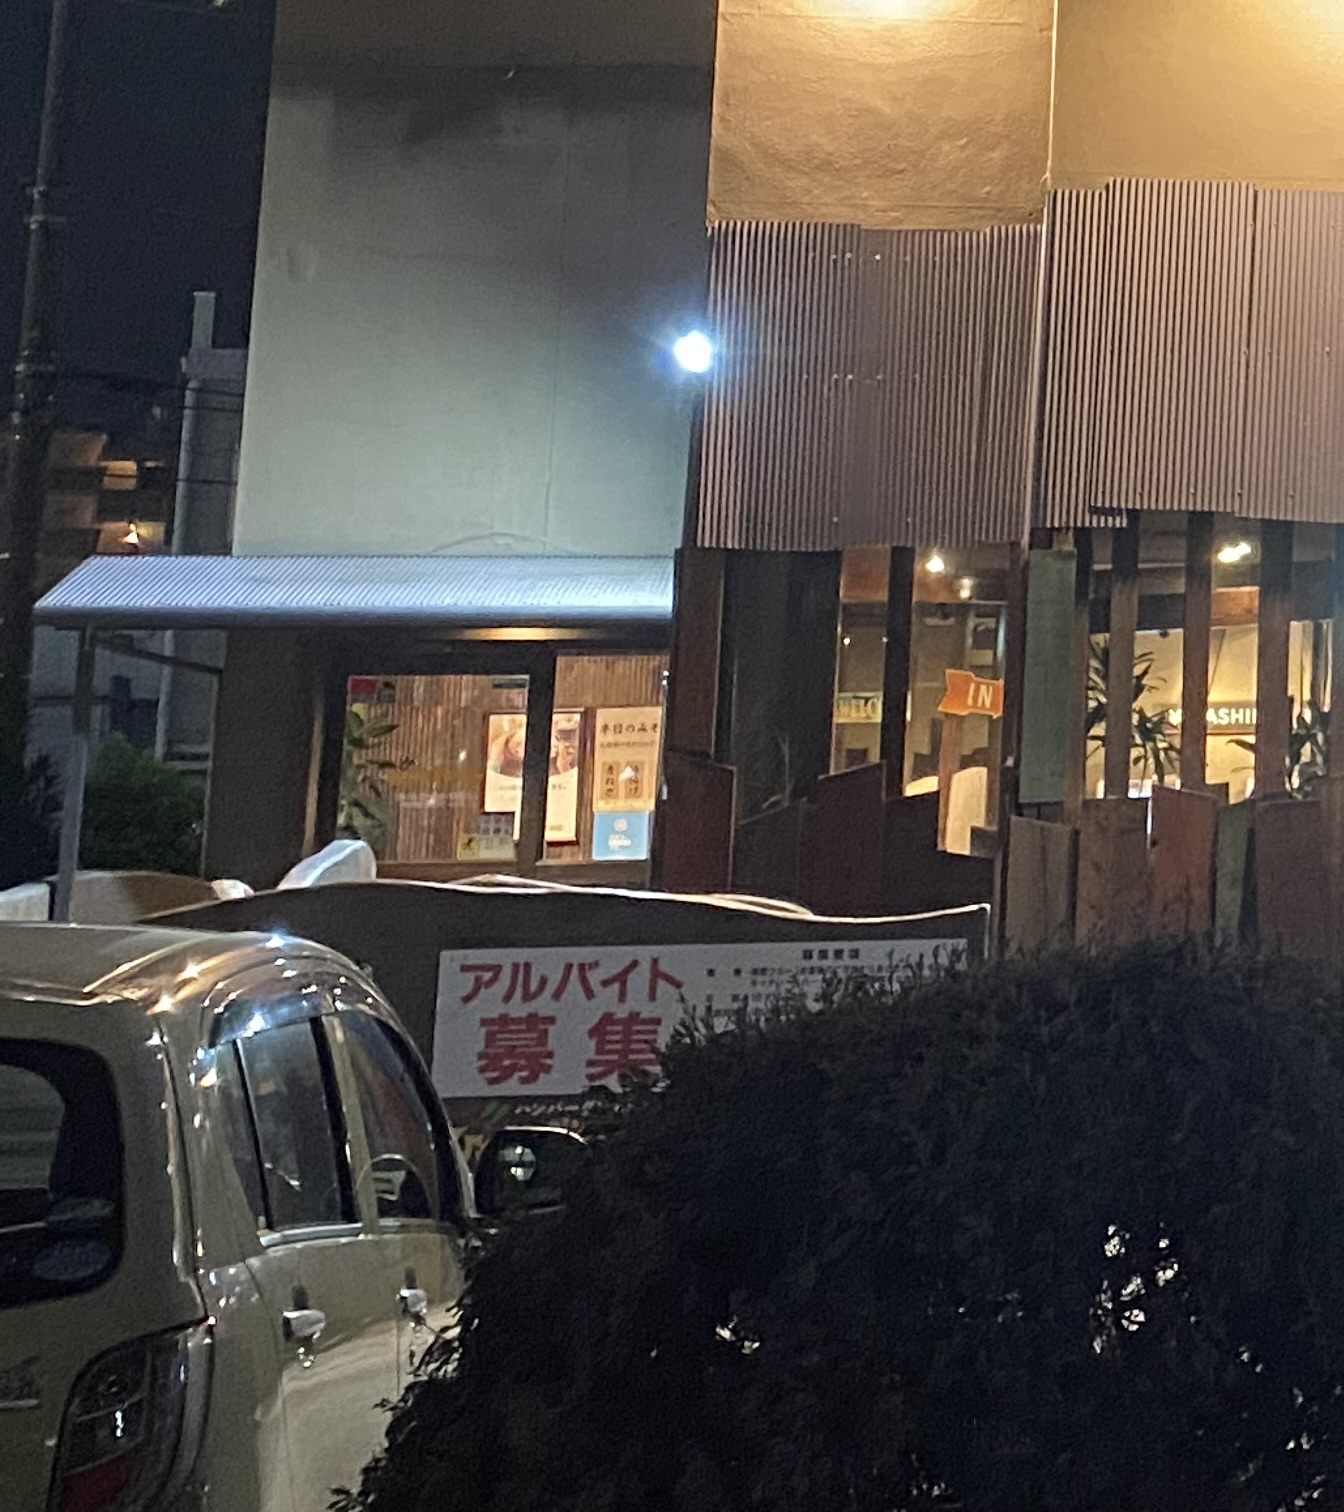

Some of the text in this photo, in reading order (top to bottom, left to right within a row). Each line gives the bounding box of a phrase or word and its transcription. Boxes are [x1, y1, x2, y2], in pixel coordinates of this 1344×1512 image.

[967, 682, 993, 709] IN
[459, 956, 684, 1005] アルバイト
[476, 1011, 663, 1086] 募集
